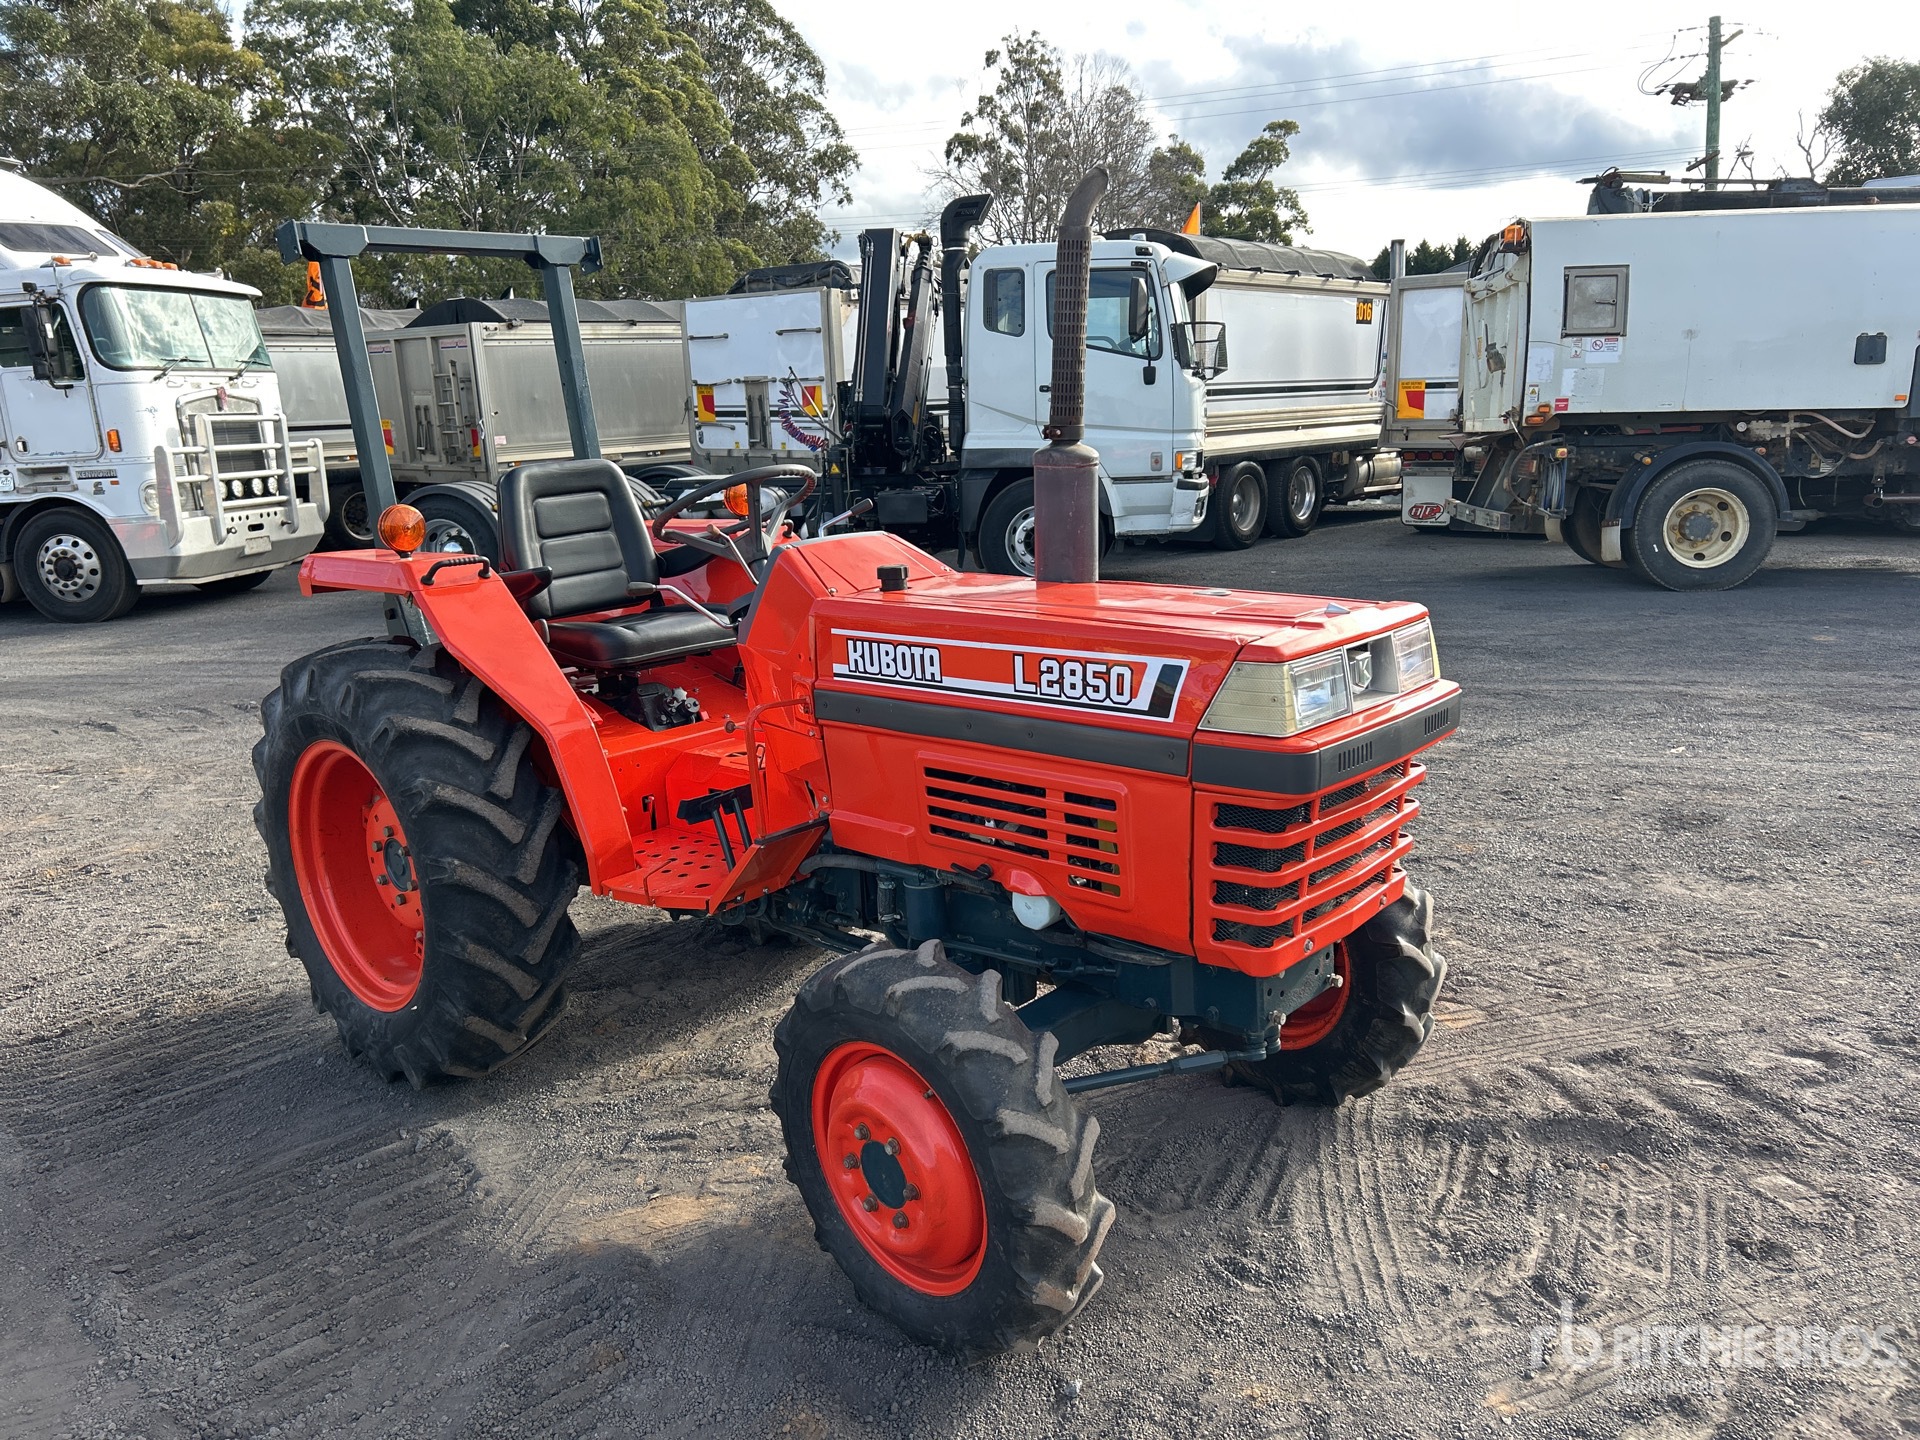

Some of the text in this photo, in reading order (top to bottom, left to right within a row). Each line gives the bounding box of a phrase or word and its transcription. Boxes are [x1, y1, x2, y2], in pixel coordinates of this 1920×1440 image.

[76, 469, 117, 478] KENWORTH
[846, 638, 1133, 705] KUBOTA L2850
